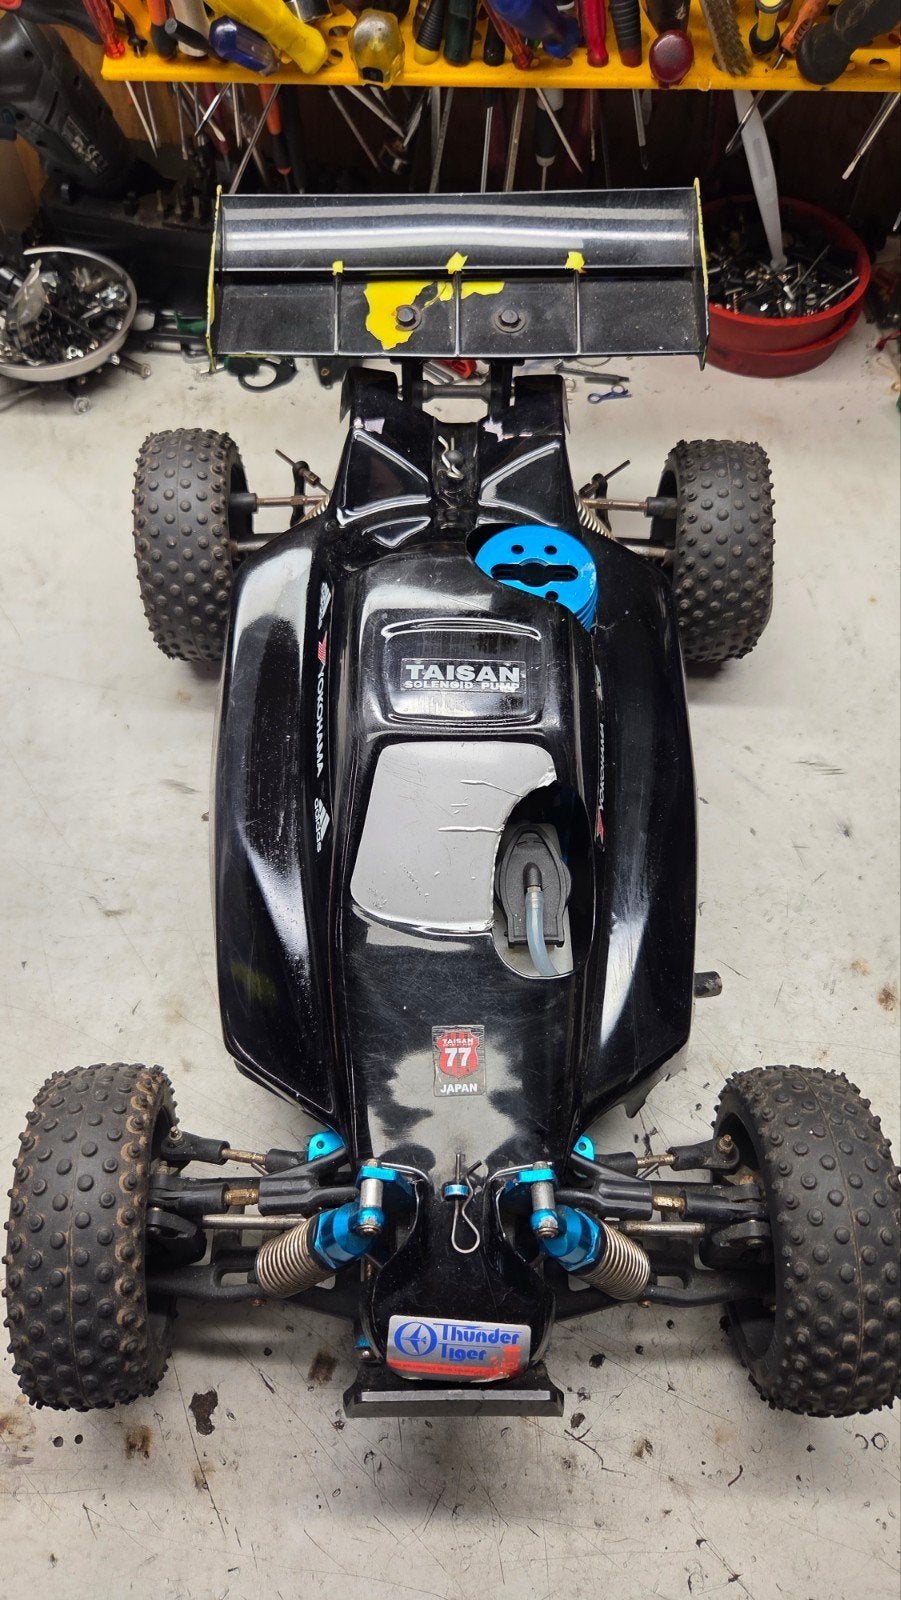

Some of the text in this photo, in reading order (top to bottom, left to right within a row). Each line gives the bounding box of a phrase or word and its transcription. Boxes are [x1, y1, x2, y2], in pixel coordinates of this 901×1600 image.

[405, 664, 520, 682] TAISAN
[404, 680, 520, 692] SOLENOID PUMP
[316, 664, 325, 778] YOKOHAMA
[314, 797, 322, 853] adidas
[445, 1047, 472, 1067] 77
[440, 1083, 478, 1095] JAPAN
[433, 1323, 520, 1345] Thunder
[438, 1343, 487, 1362] Tiger
